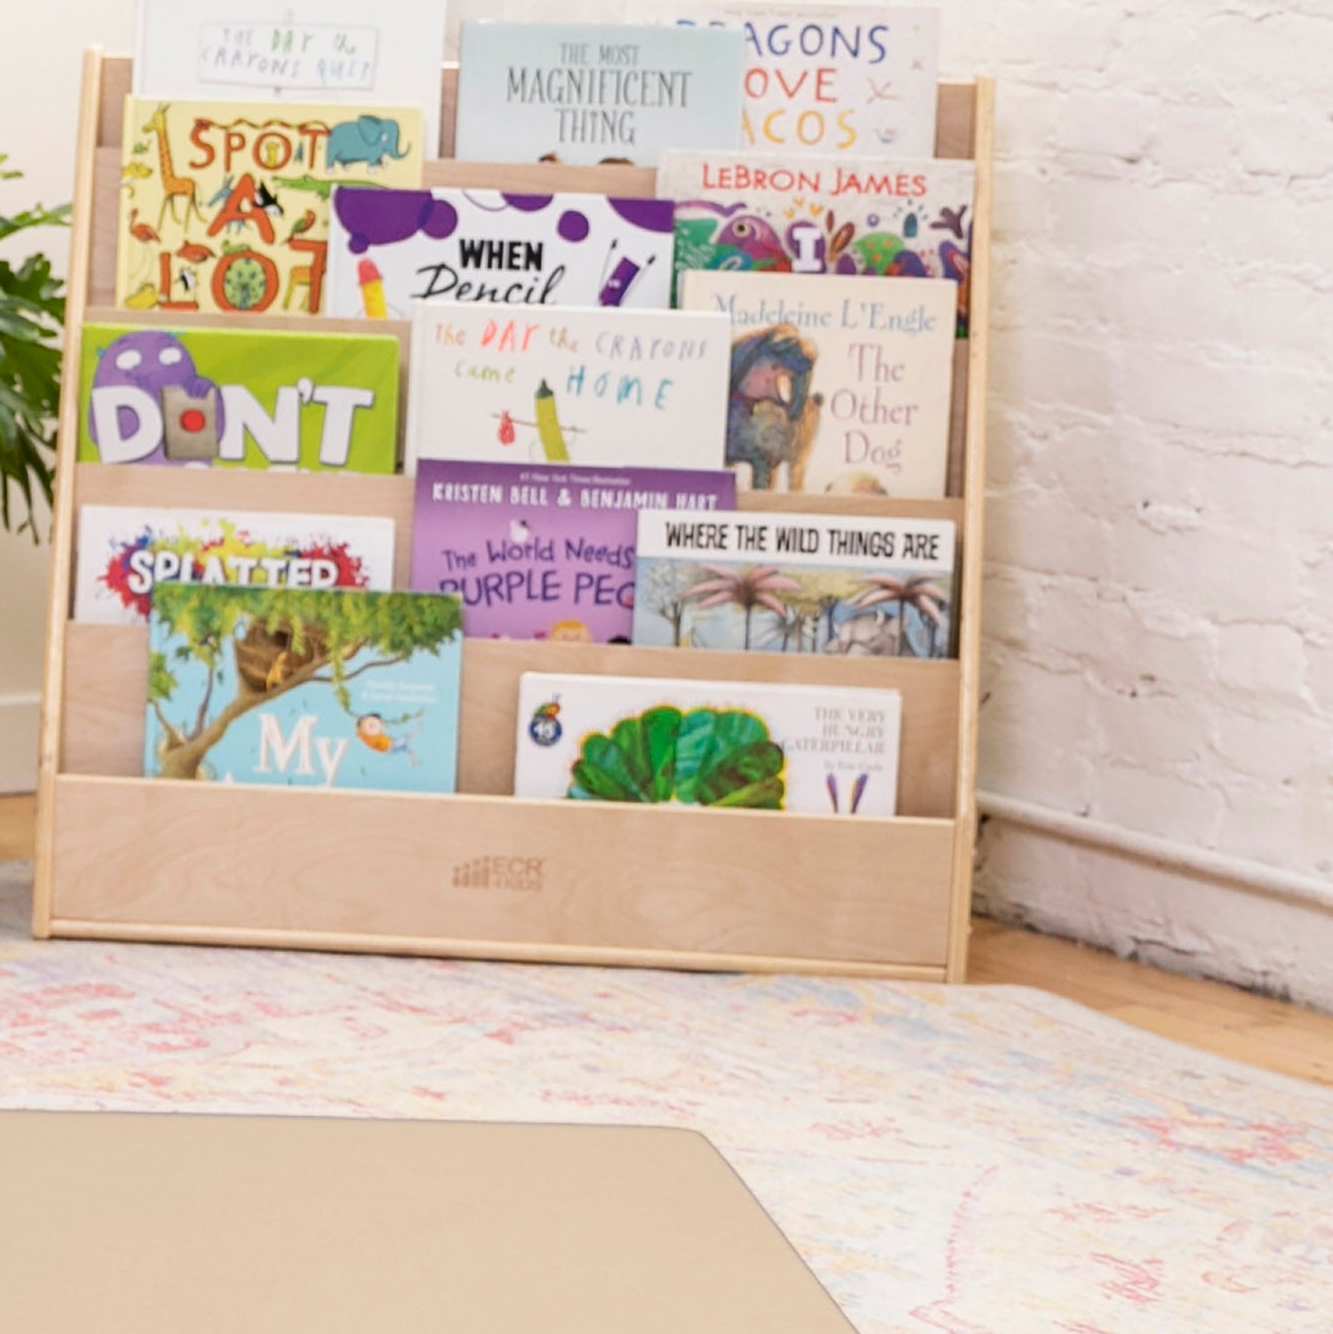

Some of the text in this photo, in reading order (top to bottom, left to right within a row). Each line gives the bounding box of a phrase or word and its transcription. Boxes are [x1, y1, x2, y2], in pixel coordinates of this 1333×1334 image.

[271, 28, 315, 53] DAY
[559, 42, 640, 66] THE MOST
[676, 20, 889, 64] AGONS
[506, 66, 693, 108] MAGNIFICENT
[744, 67, 837, 103] OVE
[188, 118, 331, 173] SPOT
[554, 107, 635, 146] THING
[741, 108, 858, 150] ACOS
[830, 167, 928, 197] JAMES
[207, 173, 276, 245] A
[459, 238, 544, 272] WHEN
[160, 238, 328, 314] LOT
[712, 293, 831, 330] Madeleine
[435, 320, 708, 361] The DAY the CRAYONS
[848, 342, 905, 384] The
[566, 364, 674, 411] HOME
[830, 387, 919, 426] Other
[844, 429, 904, 475] Dog
[433, 481, 718, 511] KRISTEN BELL & BENJAMIN HART
[442, 536, 635, 571] The World Needs
[665, 522, 941, 561] WHERE THE WILD THINGS ARE
[573, 571, 635, 609] PEO
[255, 713, 349, 788] My
